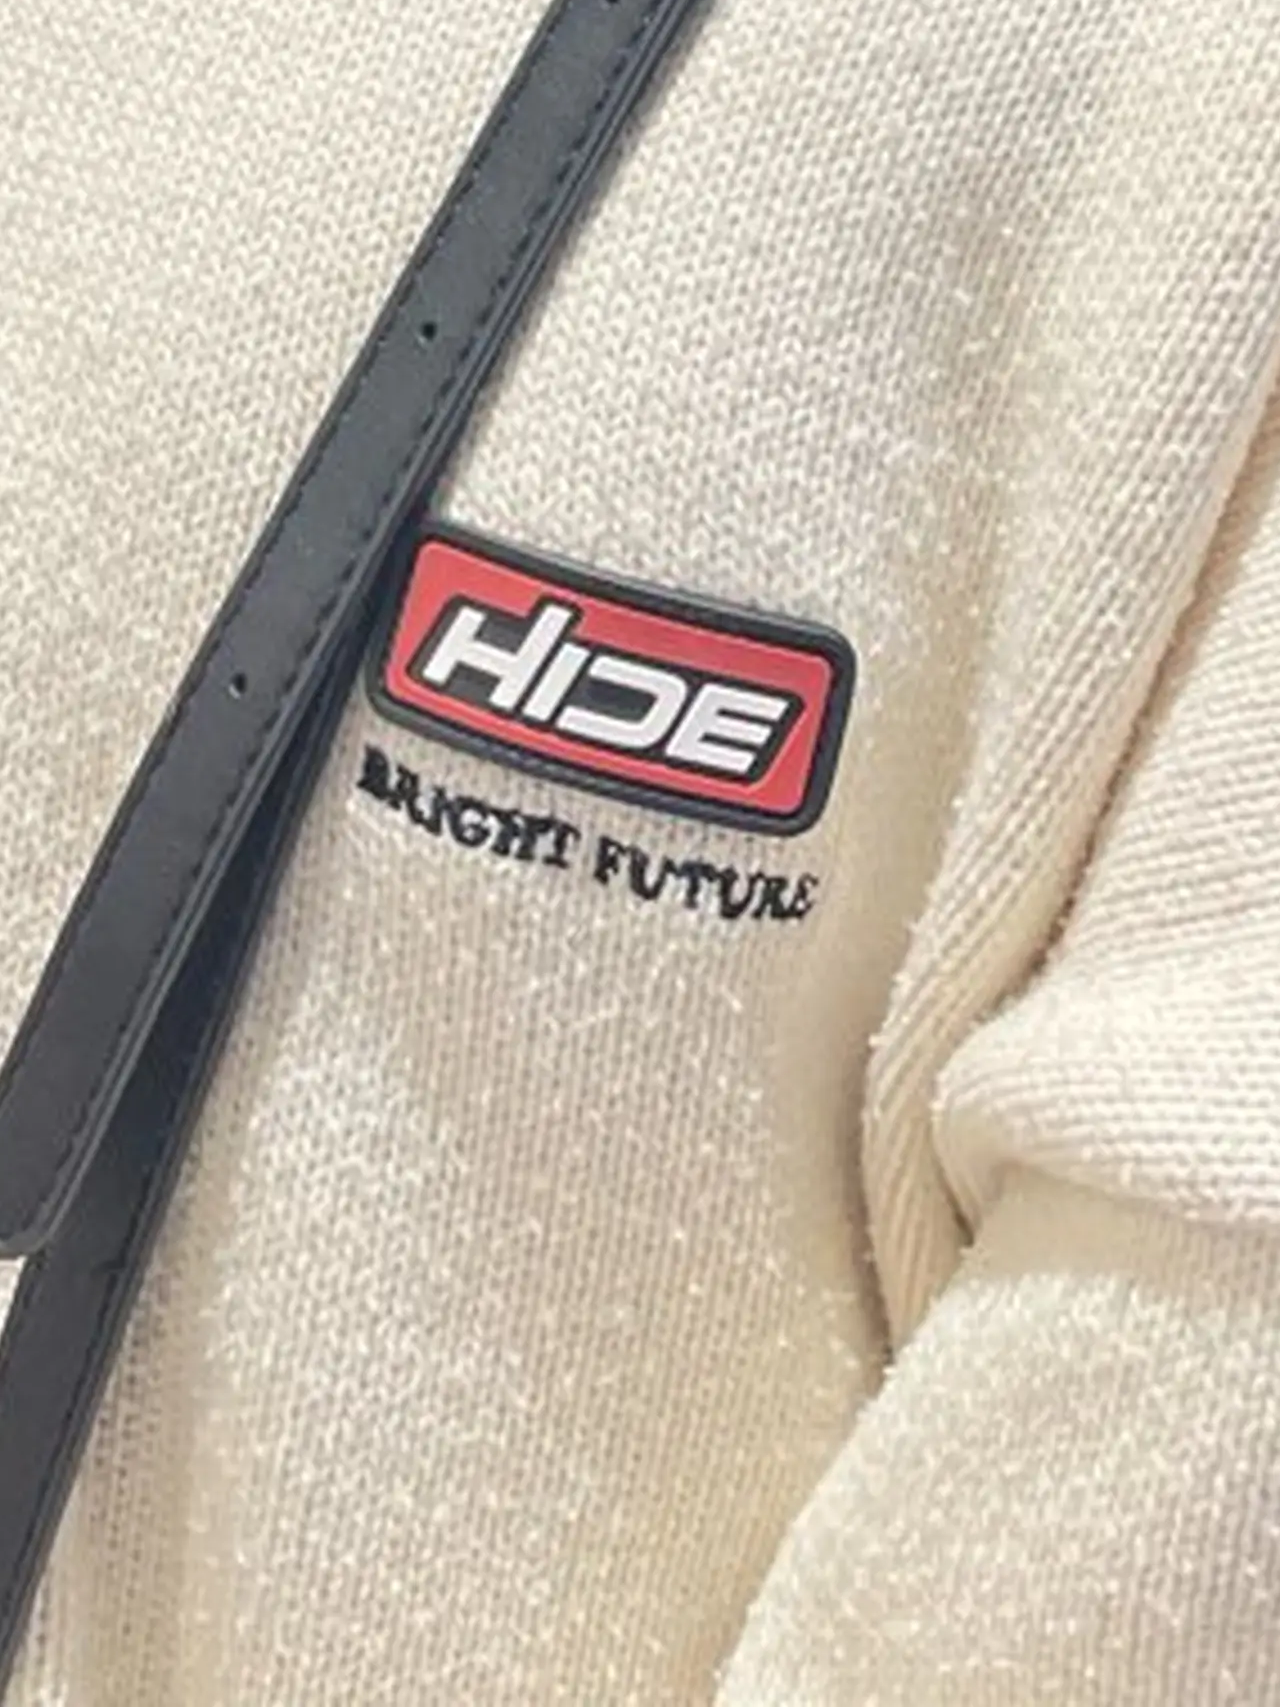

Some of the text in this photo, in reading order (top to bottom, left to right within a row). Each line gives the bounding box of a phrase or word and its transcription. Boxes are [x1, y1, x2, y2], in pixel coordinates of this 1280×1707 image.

[422, 603, 790, 775] HIDE
[357, 744, 818, 920] BRIGHT FUTURE
